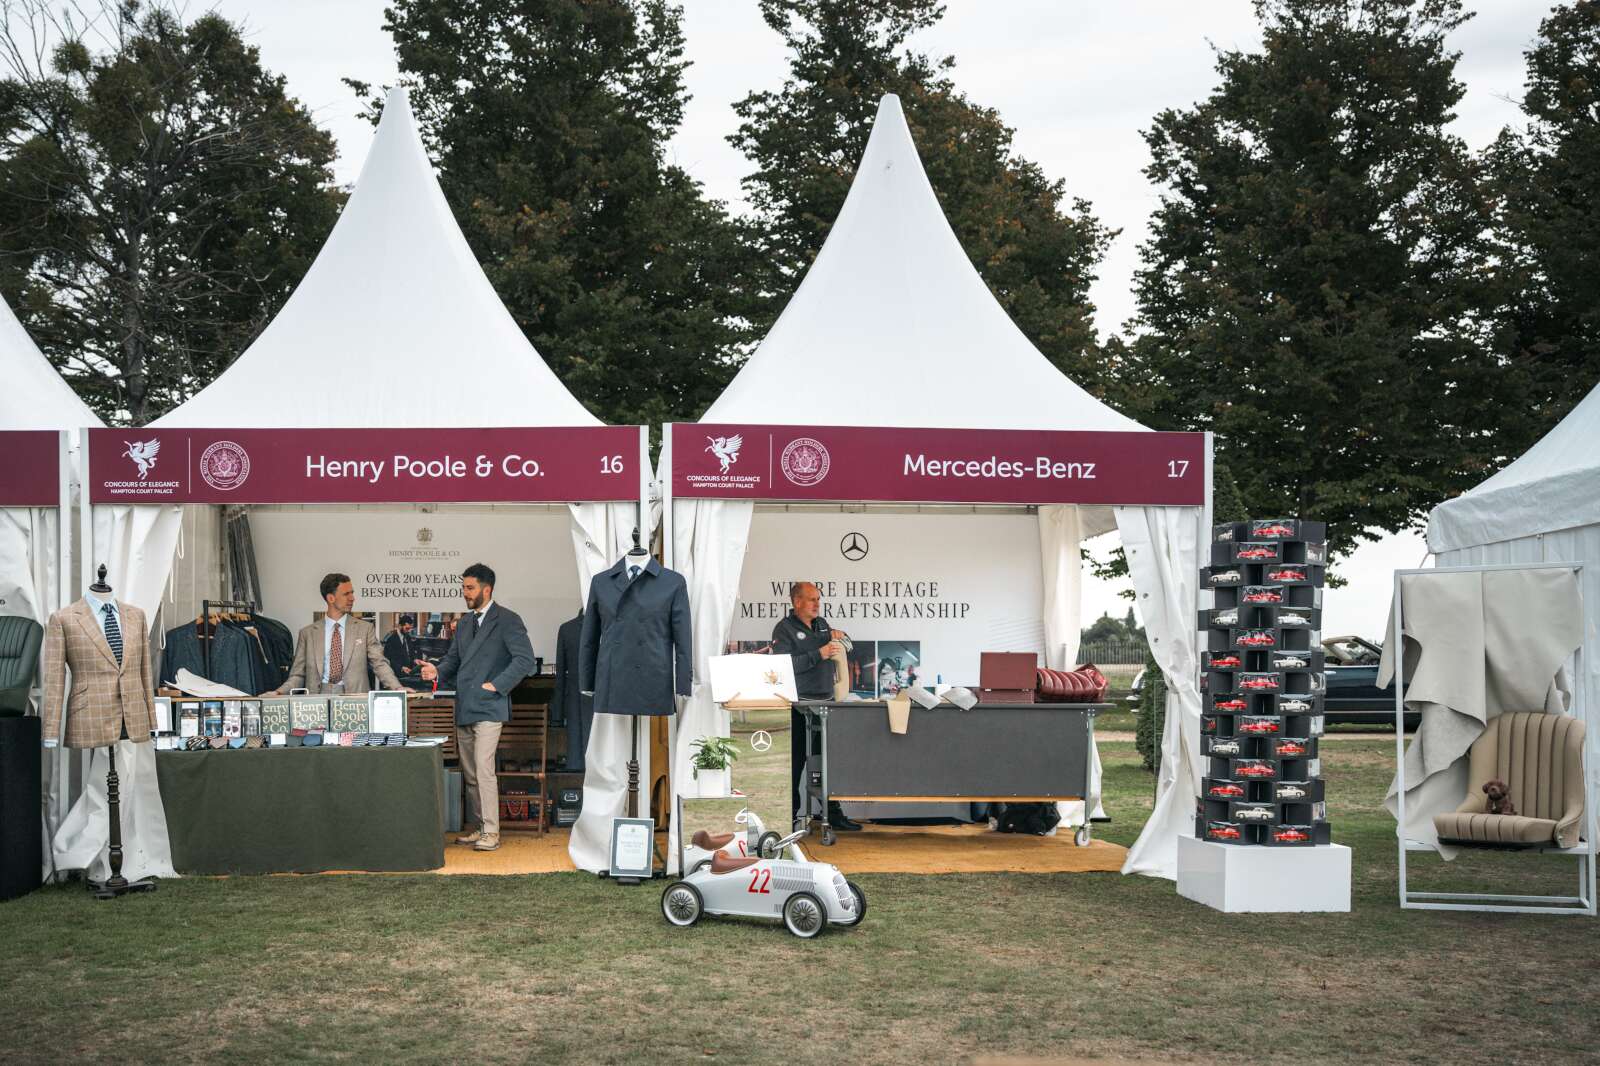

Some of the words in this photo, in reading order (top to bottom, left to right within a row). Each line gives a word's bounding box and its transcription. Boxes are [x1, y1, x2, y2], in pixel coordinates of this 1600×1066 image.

[306, 455, 385, 484] Henry
[394, 455, 467, 478] Poole
[475, 455, 494, 478] &
[502, 455, 545, 478] Co.
[600, 456, 624, 474] 16
[903, 453, 1096, 479] Mercedes-Benz
[1167, 460, 1190, 478] 17
[366, 573, 400, 584] OVER
[403, 573, 422, 584] 200
[424, 573, 464, 584] YEARS
[361, 587, 419, 598] BESPOKE
[846, 582, 939, 598] HERITAGE
[823, 602, 971, 618] RAFTSMANSHIP
[262, 702, 288, 713] enry
[293, 701, 327, 713] Henry
[333, 700, 368, 713] Henry
[262, 711, 289, 722] oole
[293, 711, 328, 723] Poole
[333, 710, 368, 721] Poole
[333, 721, 346, 731] &
[748, 868, 770, 893] 22
